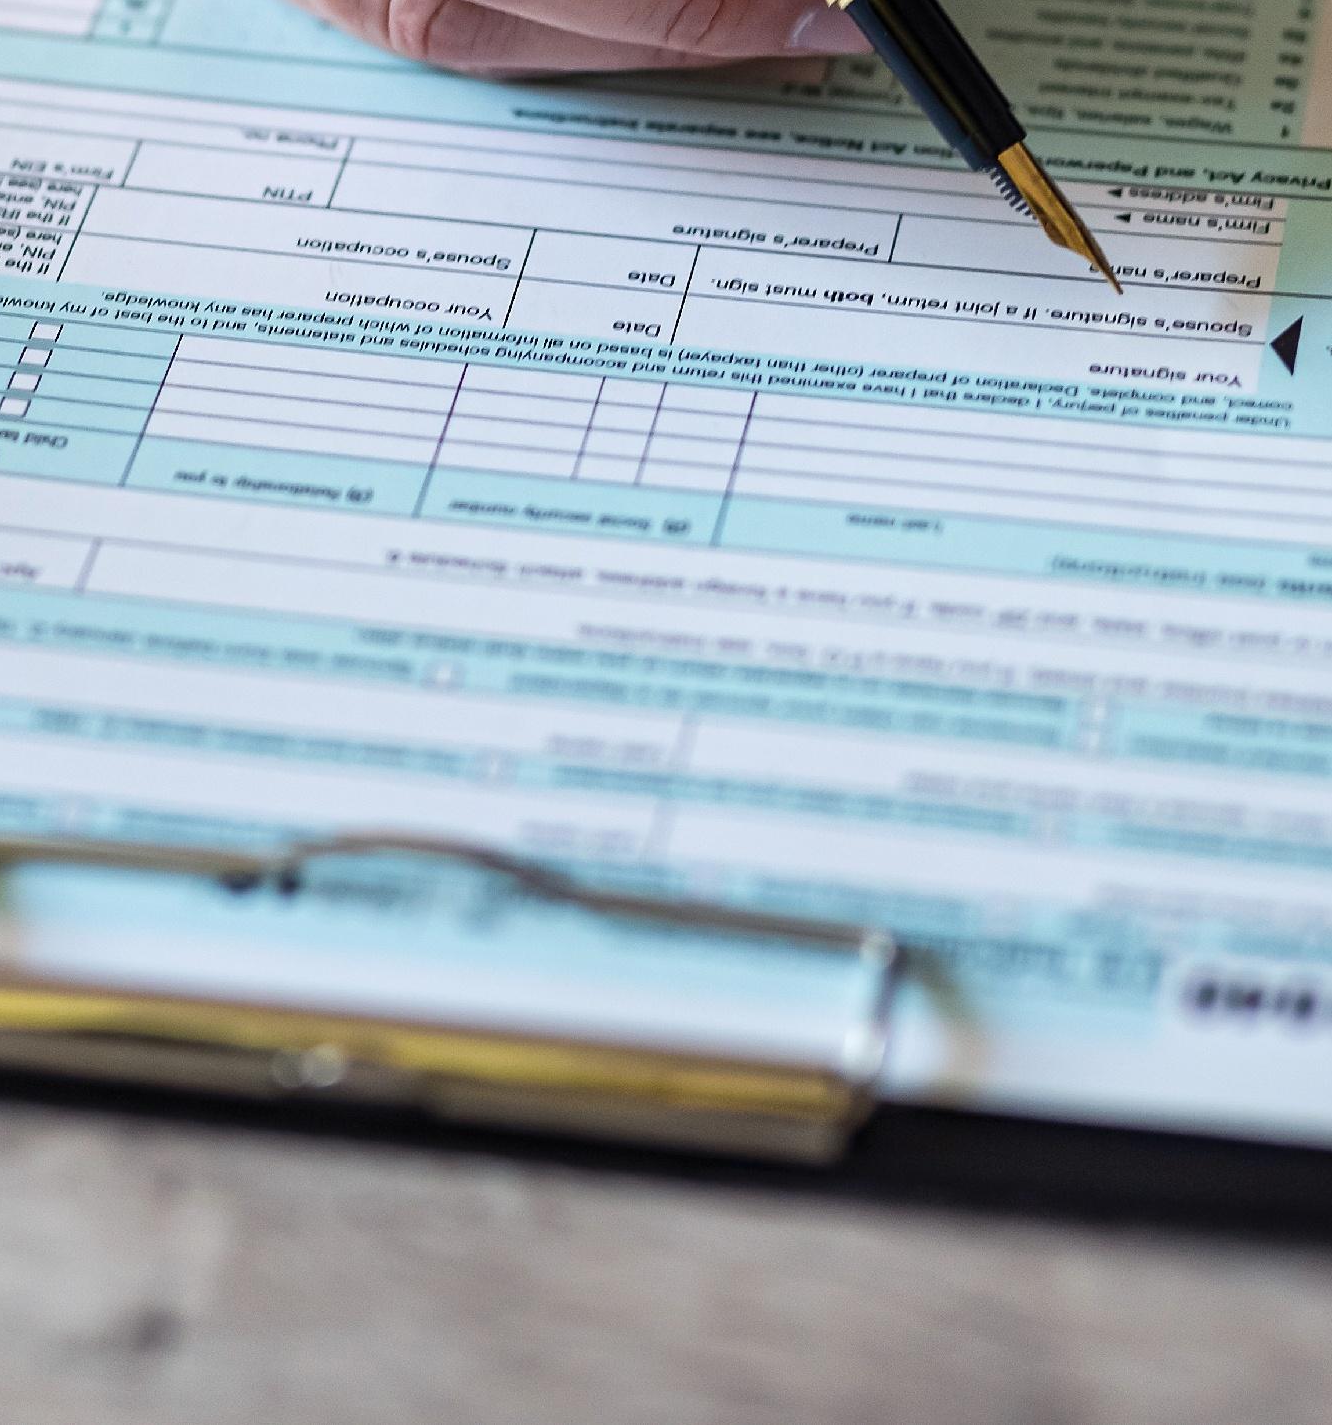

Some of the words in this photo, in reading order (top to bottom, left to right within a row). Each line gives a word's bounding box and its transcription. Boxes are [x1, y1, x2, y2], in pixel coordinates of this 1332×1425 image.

[1153, 165, 1197, 180] and
[1202, 166, 1247, 186] Act,
[1249, 170, 1332, 192] Privacy
[261, 185, 314, 203] PTIN
[1127, 184, 1213, 205] address
[1210, 191, 1276, 211] Firm's
[1138, 209, 1207, 228] name
[1204, 214, 1276, 235] Firm's
[671, 224, 767, 245] signature
[20, 242, 57, 261] PIN,
[296, 237, 410, 258] occupation
[772, 234, 880, 257] Preparer's
[4, 258, 34, 274] the
[415, 249, 512, 271] Spouse's
[627, 271, 677, 288] Date
[710, 277, 760, 296] sign.
[1152, 268, 1262, 290] Preparer's
[764, 283, 818, 299] must
[822, 289, 875, 307] both
[881, 291, 949, 311] return,
[324, 290, 441, 313] occupation
[954, 300, 1001, 318] joint
[443, 302, 493, 322] Your
[1045, 307, 1148, 330] signature.
[612, 320, 662, 339] Date
[1153, 317, 1253, 338] Spouse's
[1088, 363, 1187, 383] signature
[1193, 372, 1243, 389] Your
[22, 431, 70, 450] Child
